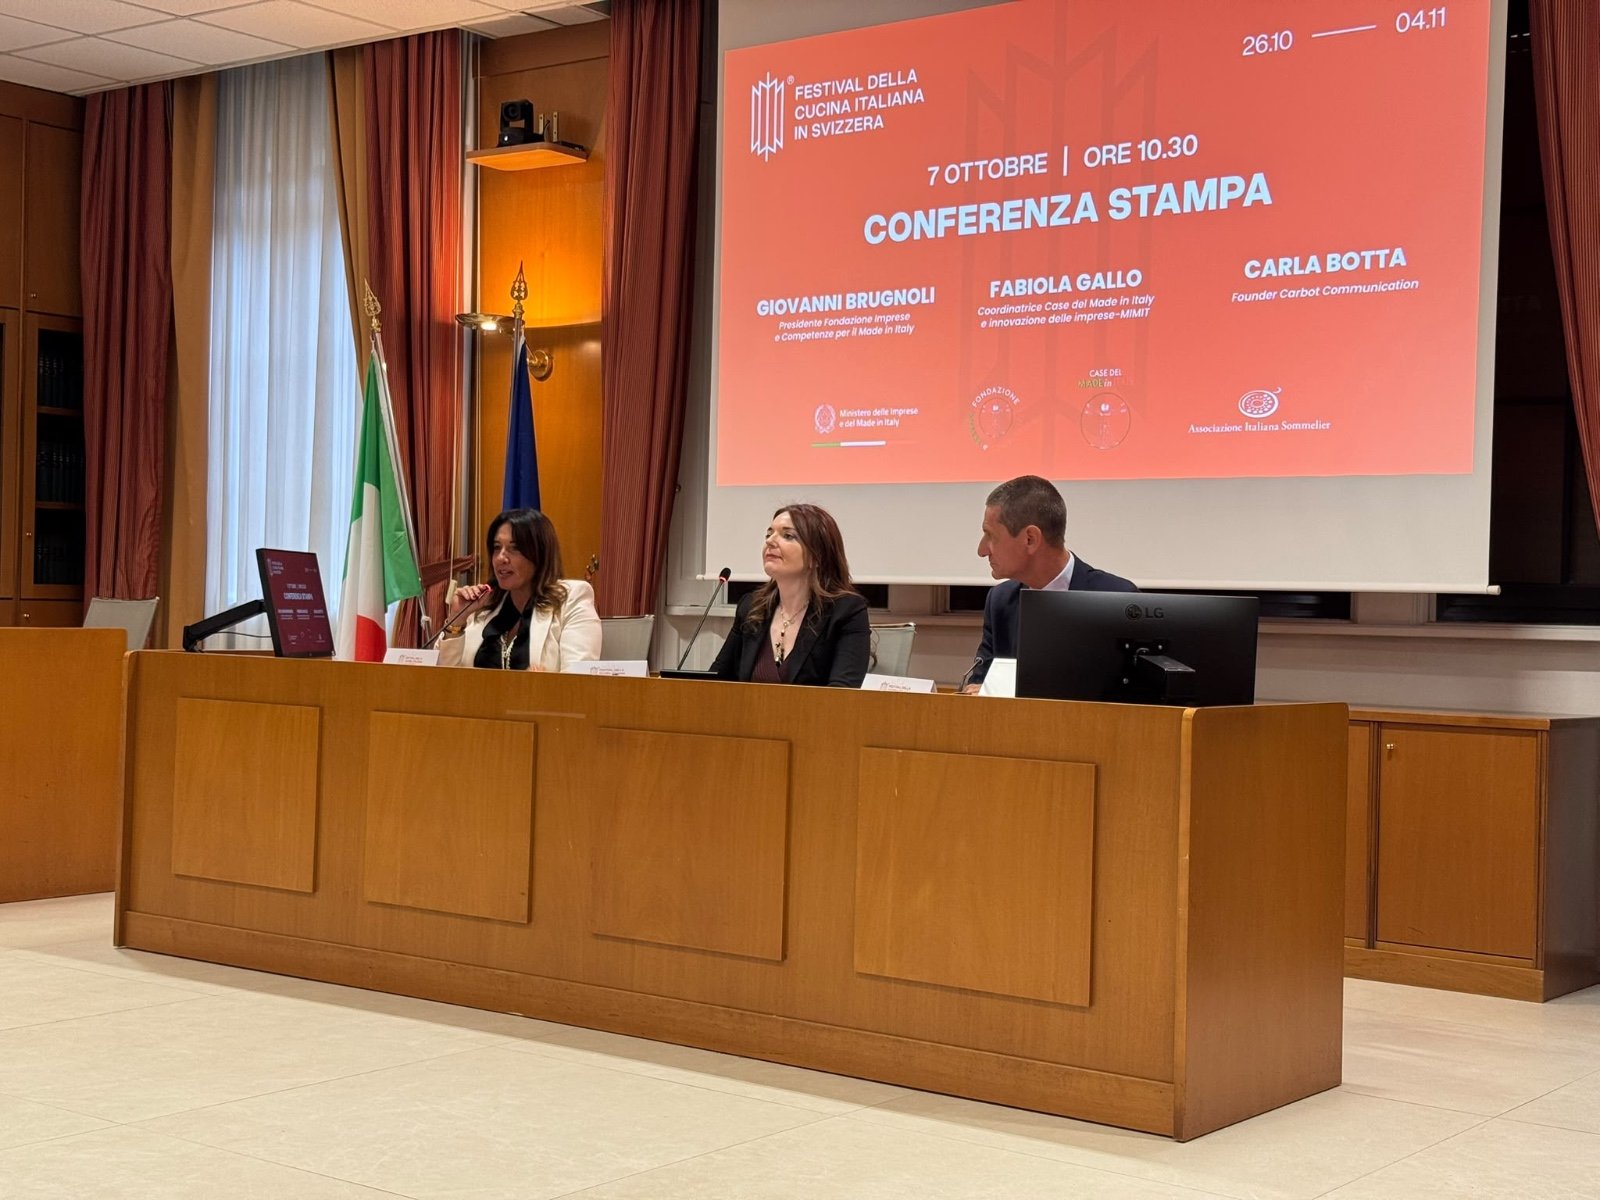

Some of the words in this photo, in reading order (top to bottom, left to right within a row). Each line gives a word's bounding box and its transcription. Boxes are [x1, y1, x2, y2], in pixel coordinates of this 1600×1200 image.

[1242, 30, 1293, 56] 26.10
[1396, 7, 1445, 32] 04.11
[795, 78, 864, 100] FESTIVAL
[868, 69, 917, 90] DELLA
[795, 99, 851, 120] CUCINA
[855, 88, 924, 111] ITALIANA
[794, 125, 808, 140] IN
[812, 114, 884, 137] SVIZZERA
[928, 166, 940, 186] 7
[944, 152, 1048, 184] OTTOBRE
[1083, 142, 1132, 168] ORE
[1138, 134, 1198, 161] 10.30
[864, 191, 1099, 245] CONFERENZA
[1108, 172, 1272, 220] STAMPA
[1244, 255, 1321, 278] CARLA
[1326, 248, 1406, 272] BOTTA
[990, 275, 1072, 298] FABIOLA
[1076, 269, 1142, 291] GALLO
[1232, 290, 1278, 302] Founder
[1280, 287, 1320, 298] Carbot
[1322, 279, 1419, 295] Communication
[757, 294, 842, 316] GIOVANNI
[846, 287, 934, 310] BRUGNOLI
[978, 302, 1042, 316] Coordinatrice
[1044, 302, 1070, 311] Case
[1072, 299, 1088, 309] del
[1089, 297, 1118, 308] Made
[1120, 296, 1130, 306] in
[1132, 294, 1155, 306] Italy
[779, 319, 822, 329] Presidente
[824, 316, 873, 326] Fondazione
[874, 313, 910, 324] Imprese
[981, 320, 987, 328] e
[989, 316, 1046, 327] innovazione
[1048, 313, 1072, 324] delle
[1074, 308, 1150, 323] imprese-MIMIT
[774, 334, 780, 342] e
[781, 331, 834, 342] Competenze
[835, 330, 850, 340] per
[851, 327, 857, 336] il
[858, 326, 883, 336] Made
[884, 326, 893, 334] in
[894, 324, 914, 334] Italy
[1089, 369, 1109, 378] CASE
[1109, 368, 1122, 376] DEL
[971, 386, 1021, 409] FONDAZIONE
[840, 409, 872, 417] Ministero
[872, 408, 889, 416] delle
[890, 408, 918, 416] Imprese
[1188, 424, 1242, 433] Associazione
[1245, 422, 1279, 431] Italiana
[1281, 420, 1331, 430] Sommelier
[1145, 607, 1164, 619] LG
